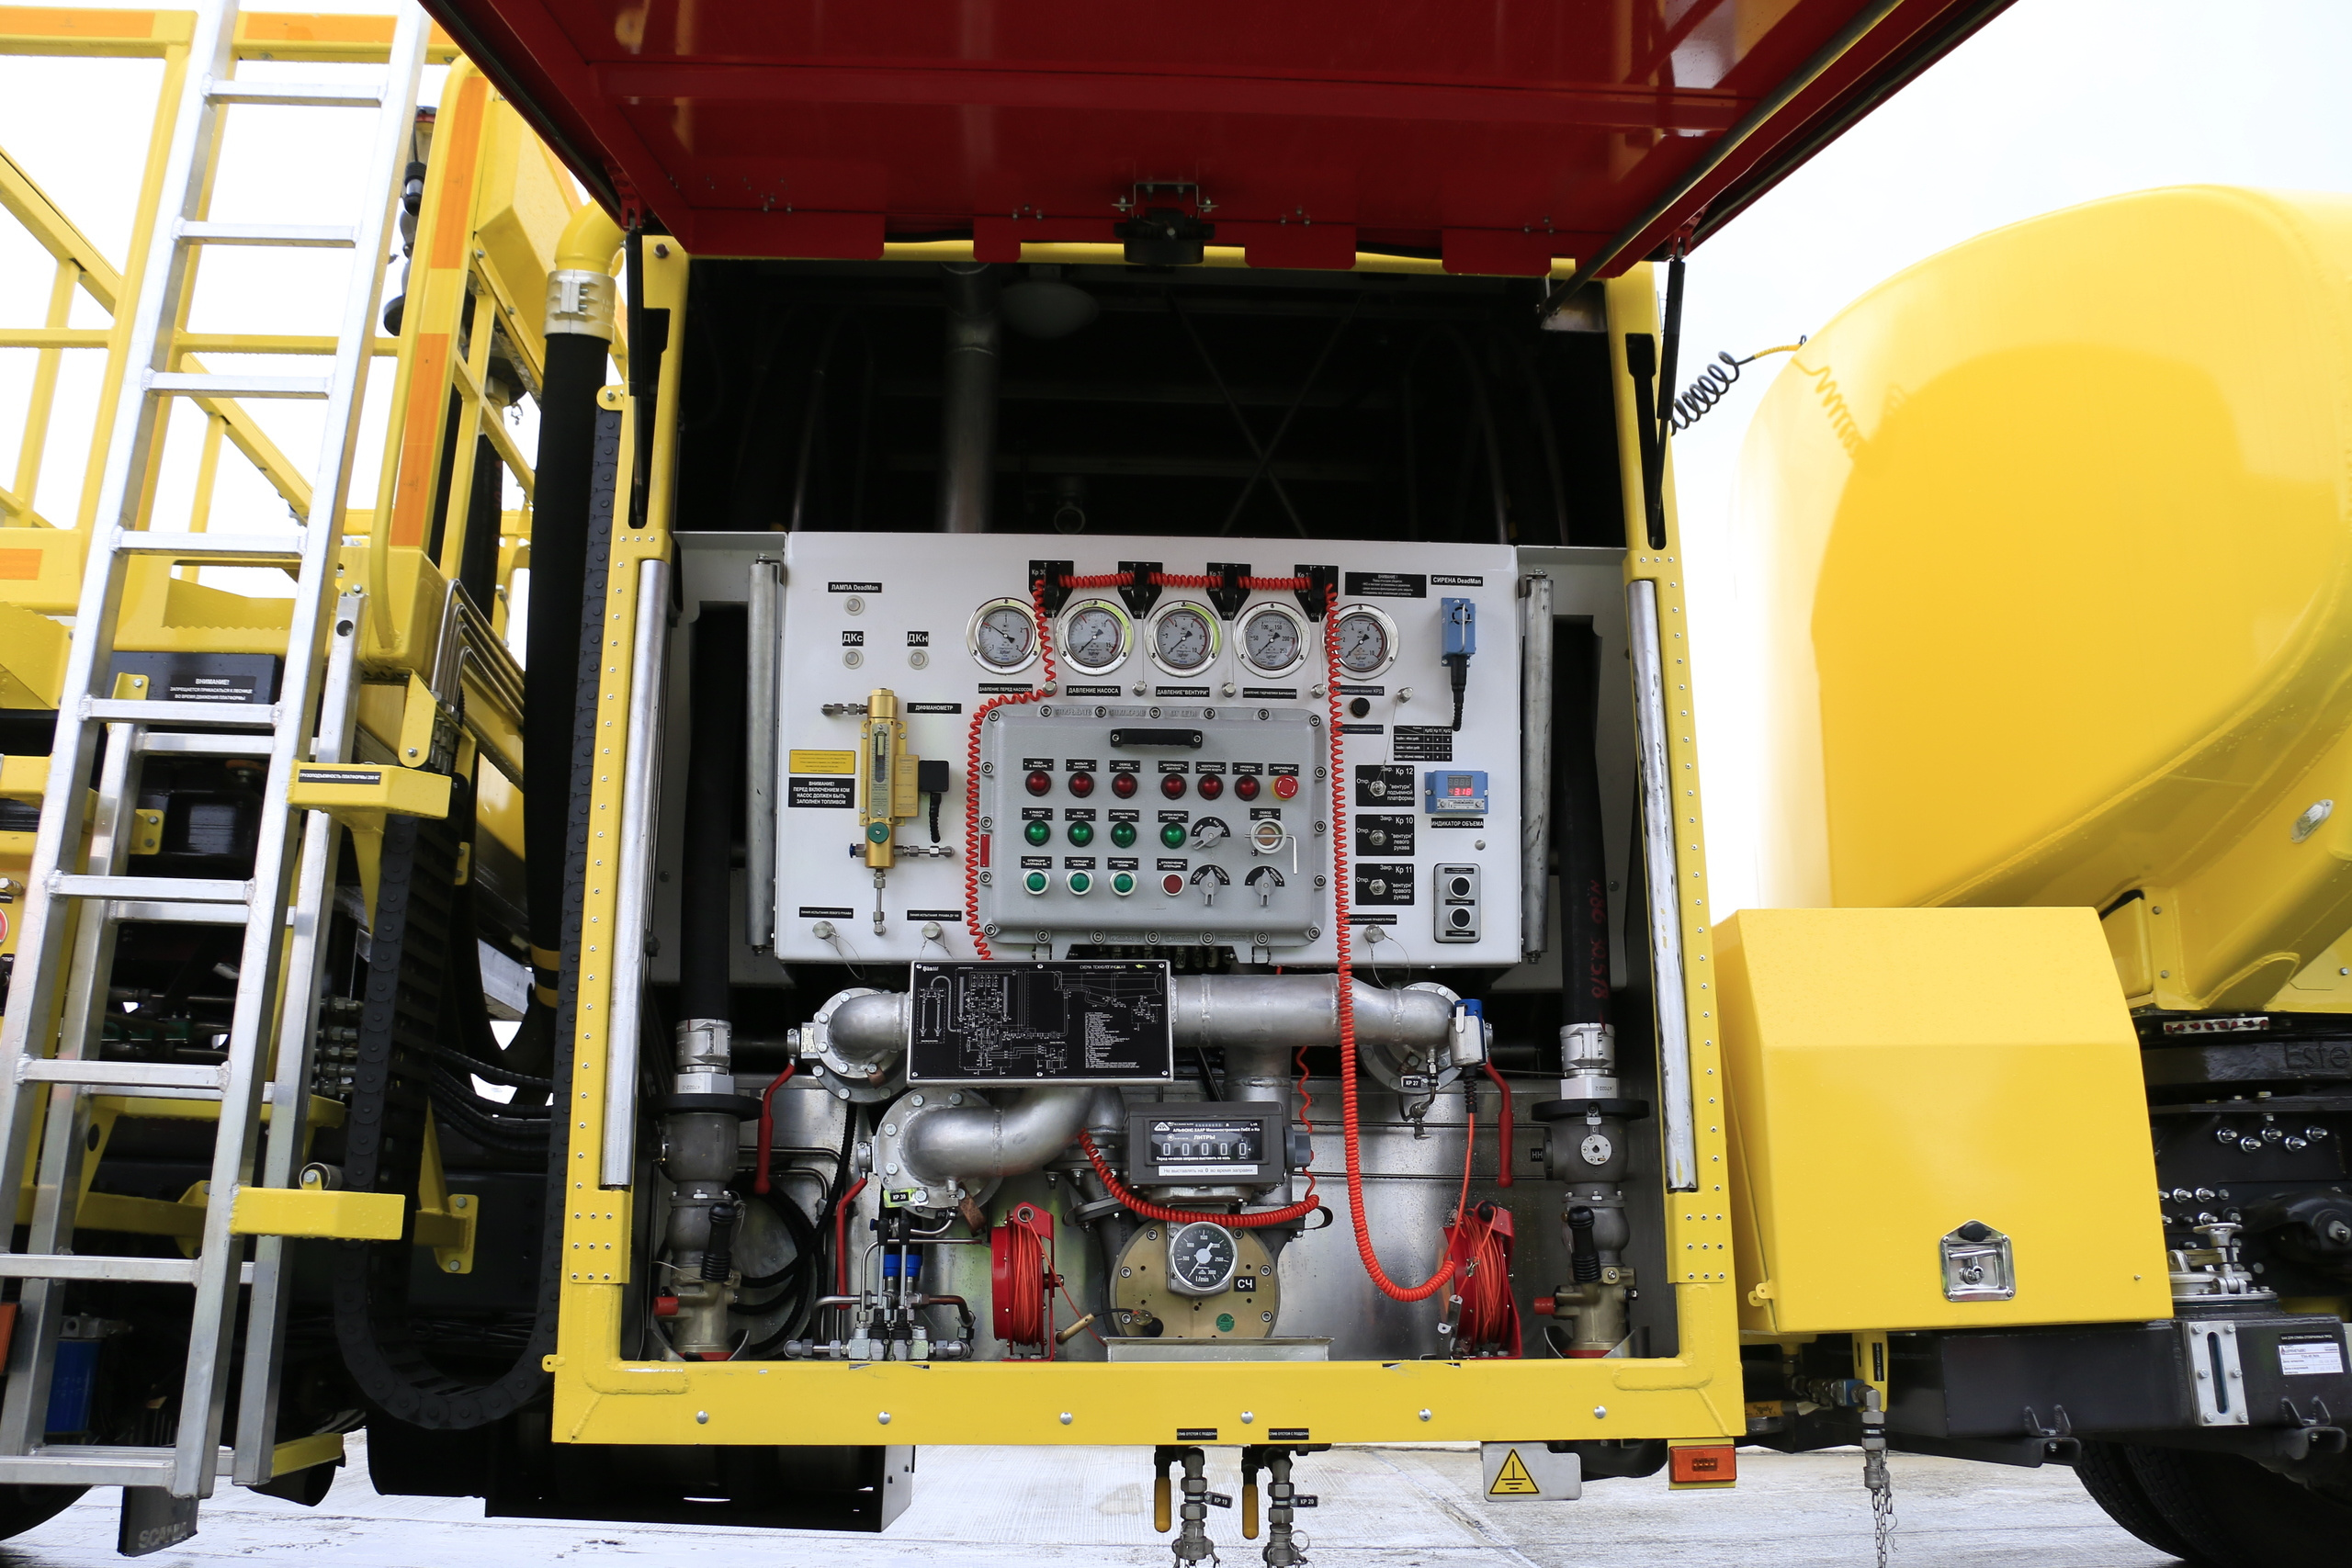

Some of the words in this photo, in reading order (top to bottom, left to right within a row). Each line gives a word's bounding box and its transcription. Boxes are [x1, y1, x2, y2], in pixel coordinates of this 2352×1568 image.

[842, 633, 863, 643] ДКс
[907, 634, 928, 643] ДКн
[1396, 817, 1404, 825] Кр
[1237, 1279, 1253, 1288] СЧ
